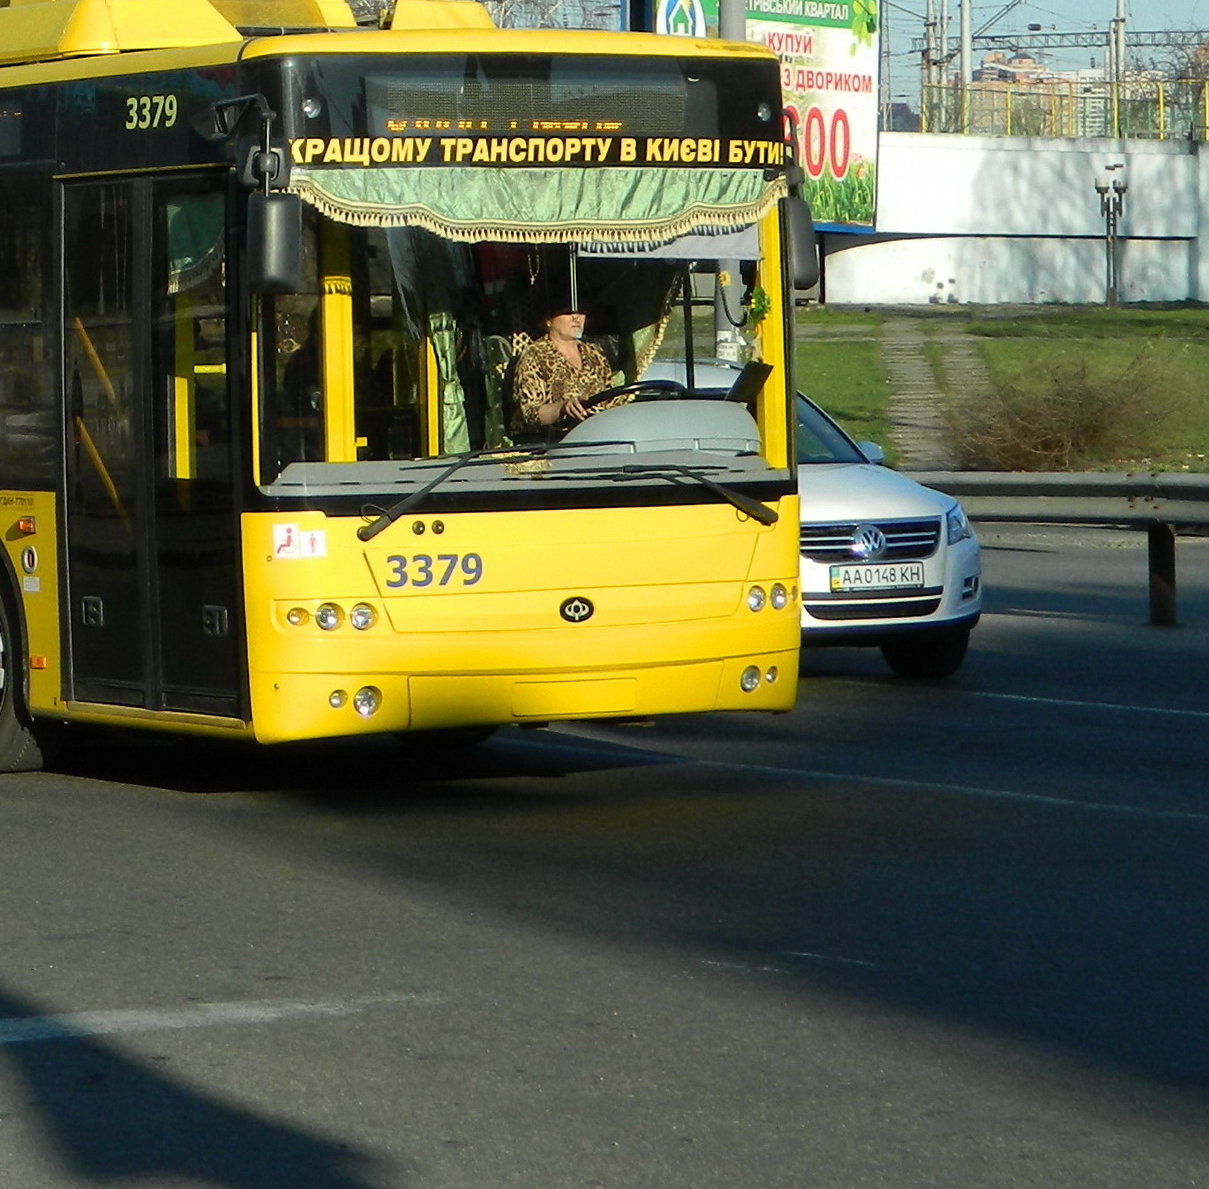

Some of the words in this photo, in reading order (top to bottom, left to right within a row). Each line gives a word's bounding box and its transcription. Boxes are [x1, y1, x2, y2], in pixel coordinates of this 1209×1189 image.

[804, 1, 849, 21] КВАРТАЛ
[767, 30, 813, 54] КУПУЙ
[795, 69, 873, 94] ДВОРИКОМ
[125, 94, 178, 131] 3379
[288, 137, 432, 167] КРАЩОМУ
[440, 137, 613, 164] ТРАНСПОРТУ
[620, 138, 638, 162] В
[646, 138, 721, 164] КИЄВІ
[728, 139, 785, 165] БУТИ!
[385, 552, 484, 588] 3379
